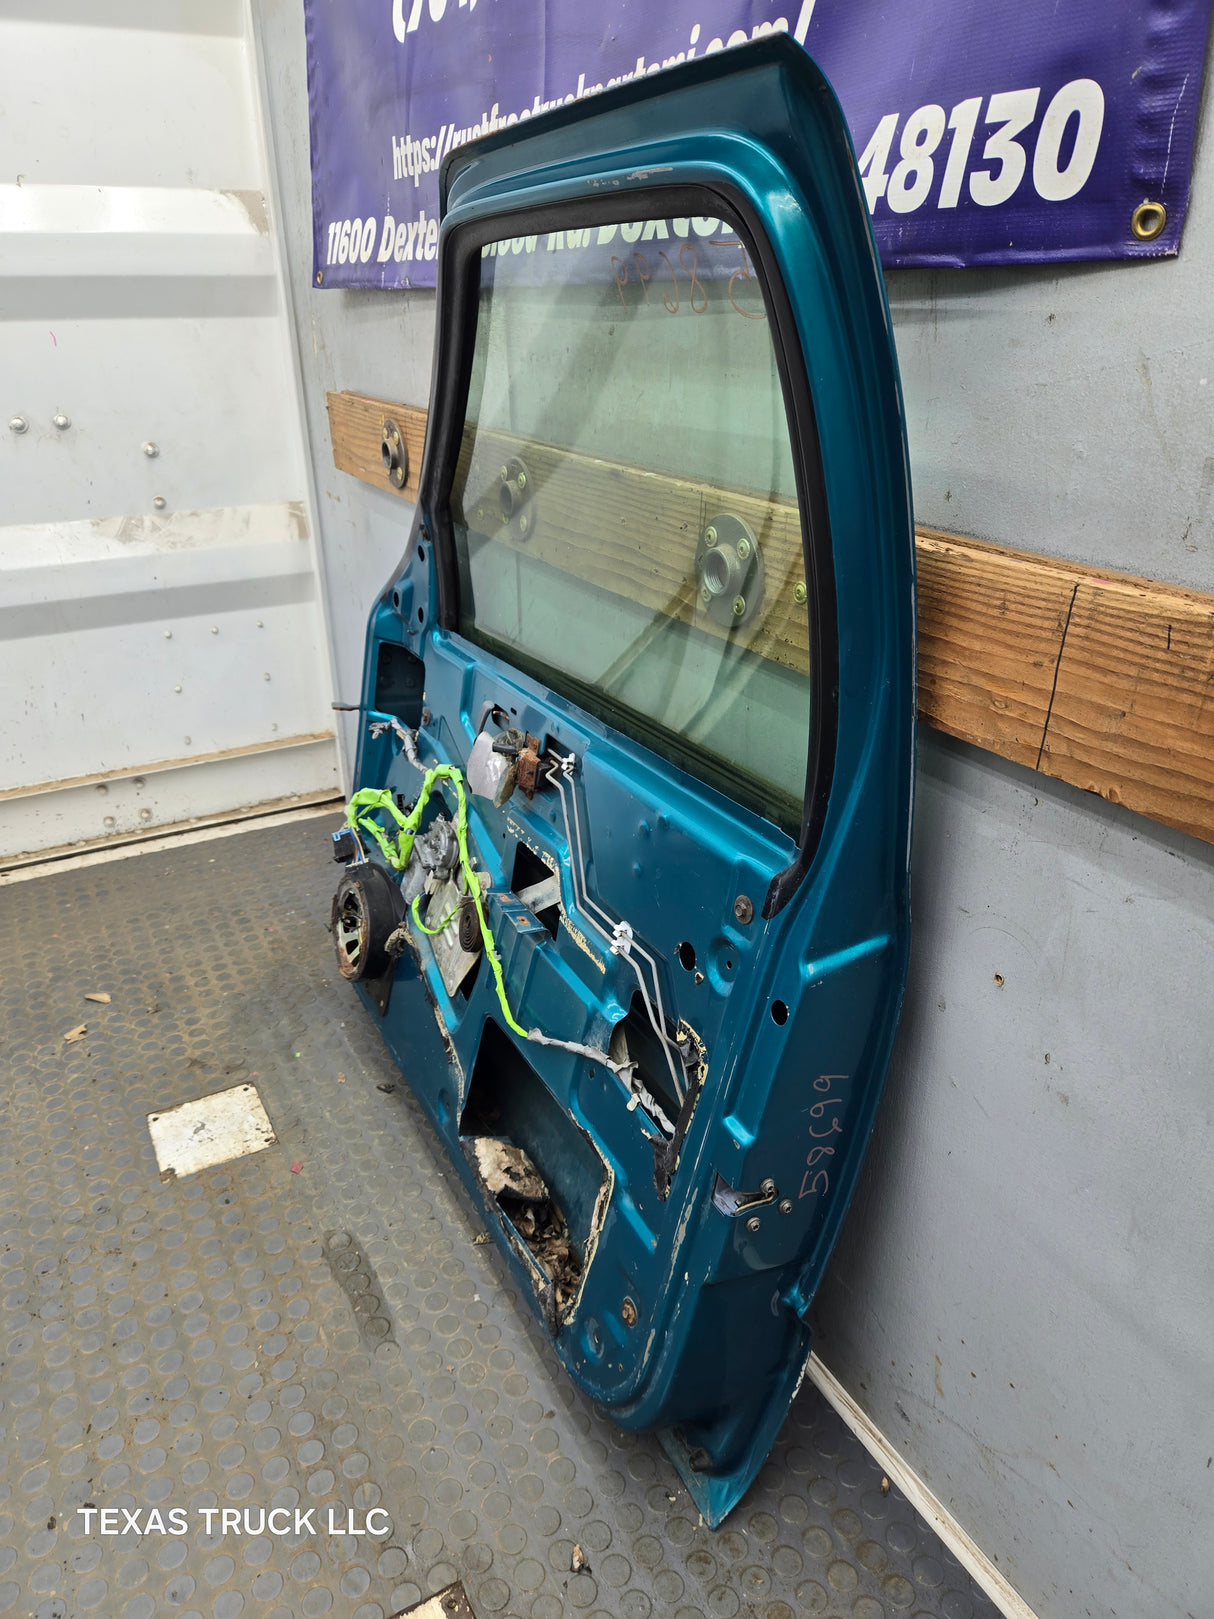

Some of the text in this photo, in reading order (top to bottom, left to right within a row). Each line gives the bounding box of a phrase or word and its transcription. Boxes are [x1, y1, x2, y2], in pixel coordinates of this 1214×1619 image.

[327, 217, 377, 264] 11600
[377, 210, 439, 263] Dexte
[857, 78, 1105, 215] 48130
